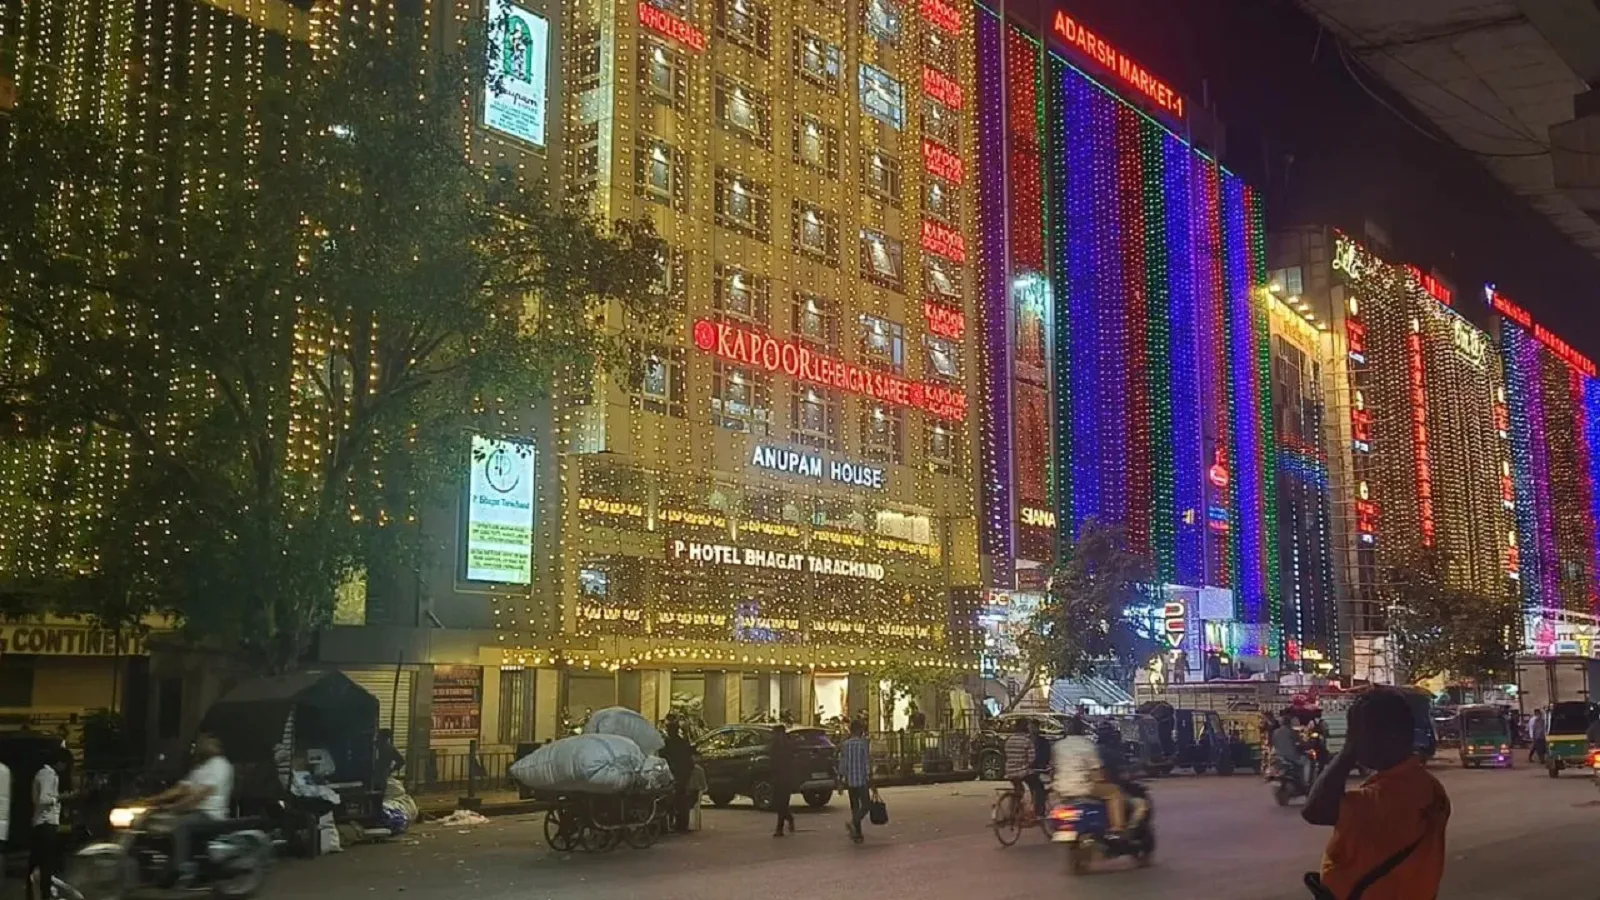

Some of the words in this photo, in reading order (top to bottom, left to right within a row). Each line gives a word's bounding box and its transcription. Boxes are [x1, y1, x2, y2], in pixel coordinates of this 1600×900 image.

[638, 1, 706, 52] WHOLESALE
[1054, 10, 1117, 71] ADARSH
[1119, 54, 1183, 117] MARKET-1
[716, 322, 815, 380] KAPOOR
[814, 358, 865, 395] LEHENGA
[864, 370, 874, 396] &
[875, 374, 910, 405] SAREE
[752, 445, 822, 477] ANUPAM
[830, 460, 882, 489] HOUSE
[675, 540, 686, 558] P
[689, 543, 741, 566] HOTEL
[744, 548, 804, 571] BHAGAT
[808, 556, 885, 580] TARACHAND
